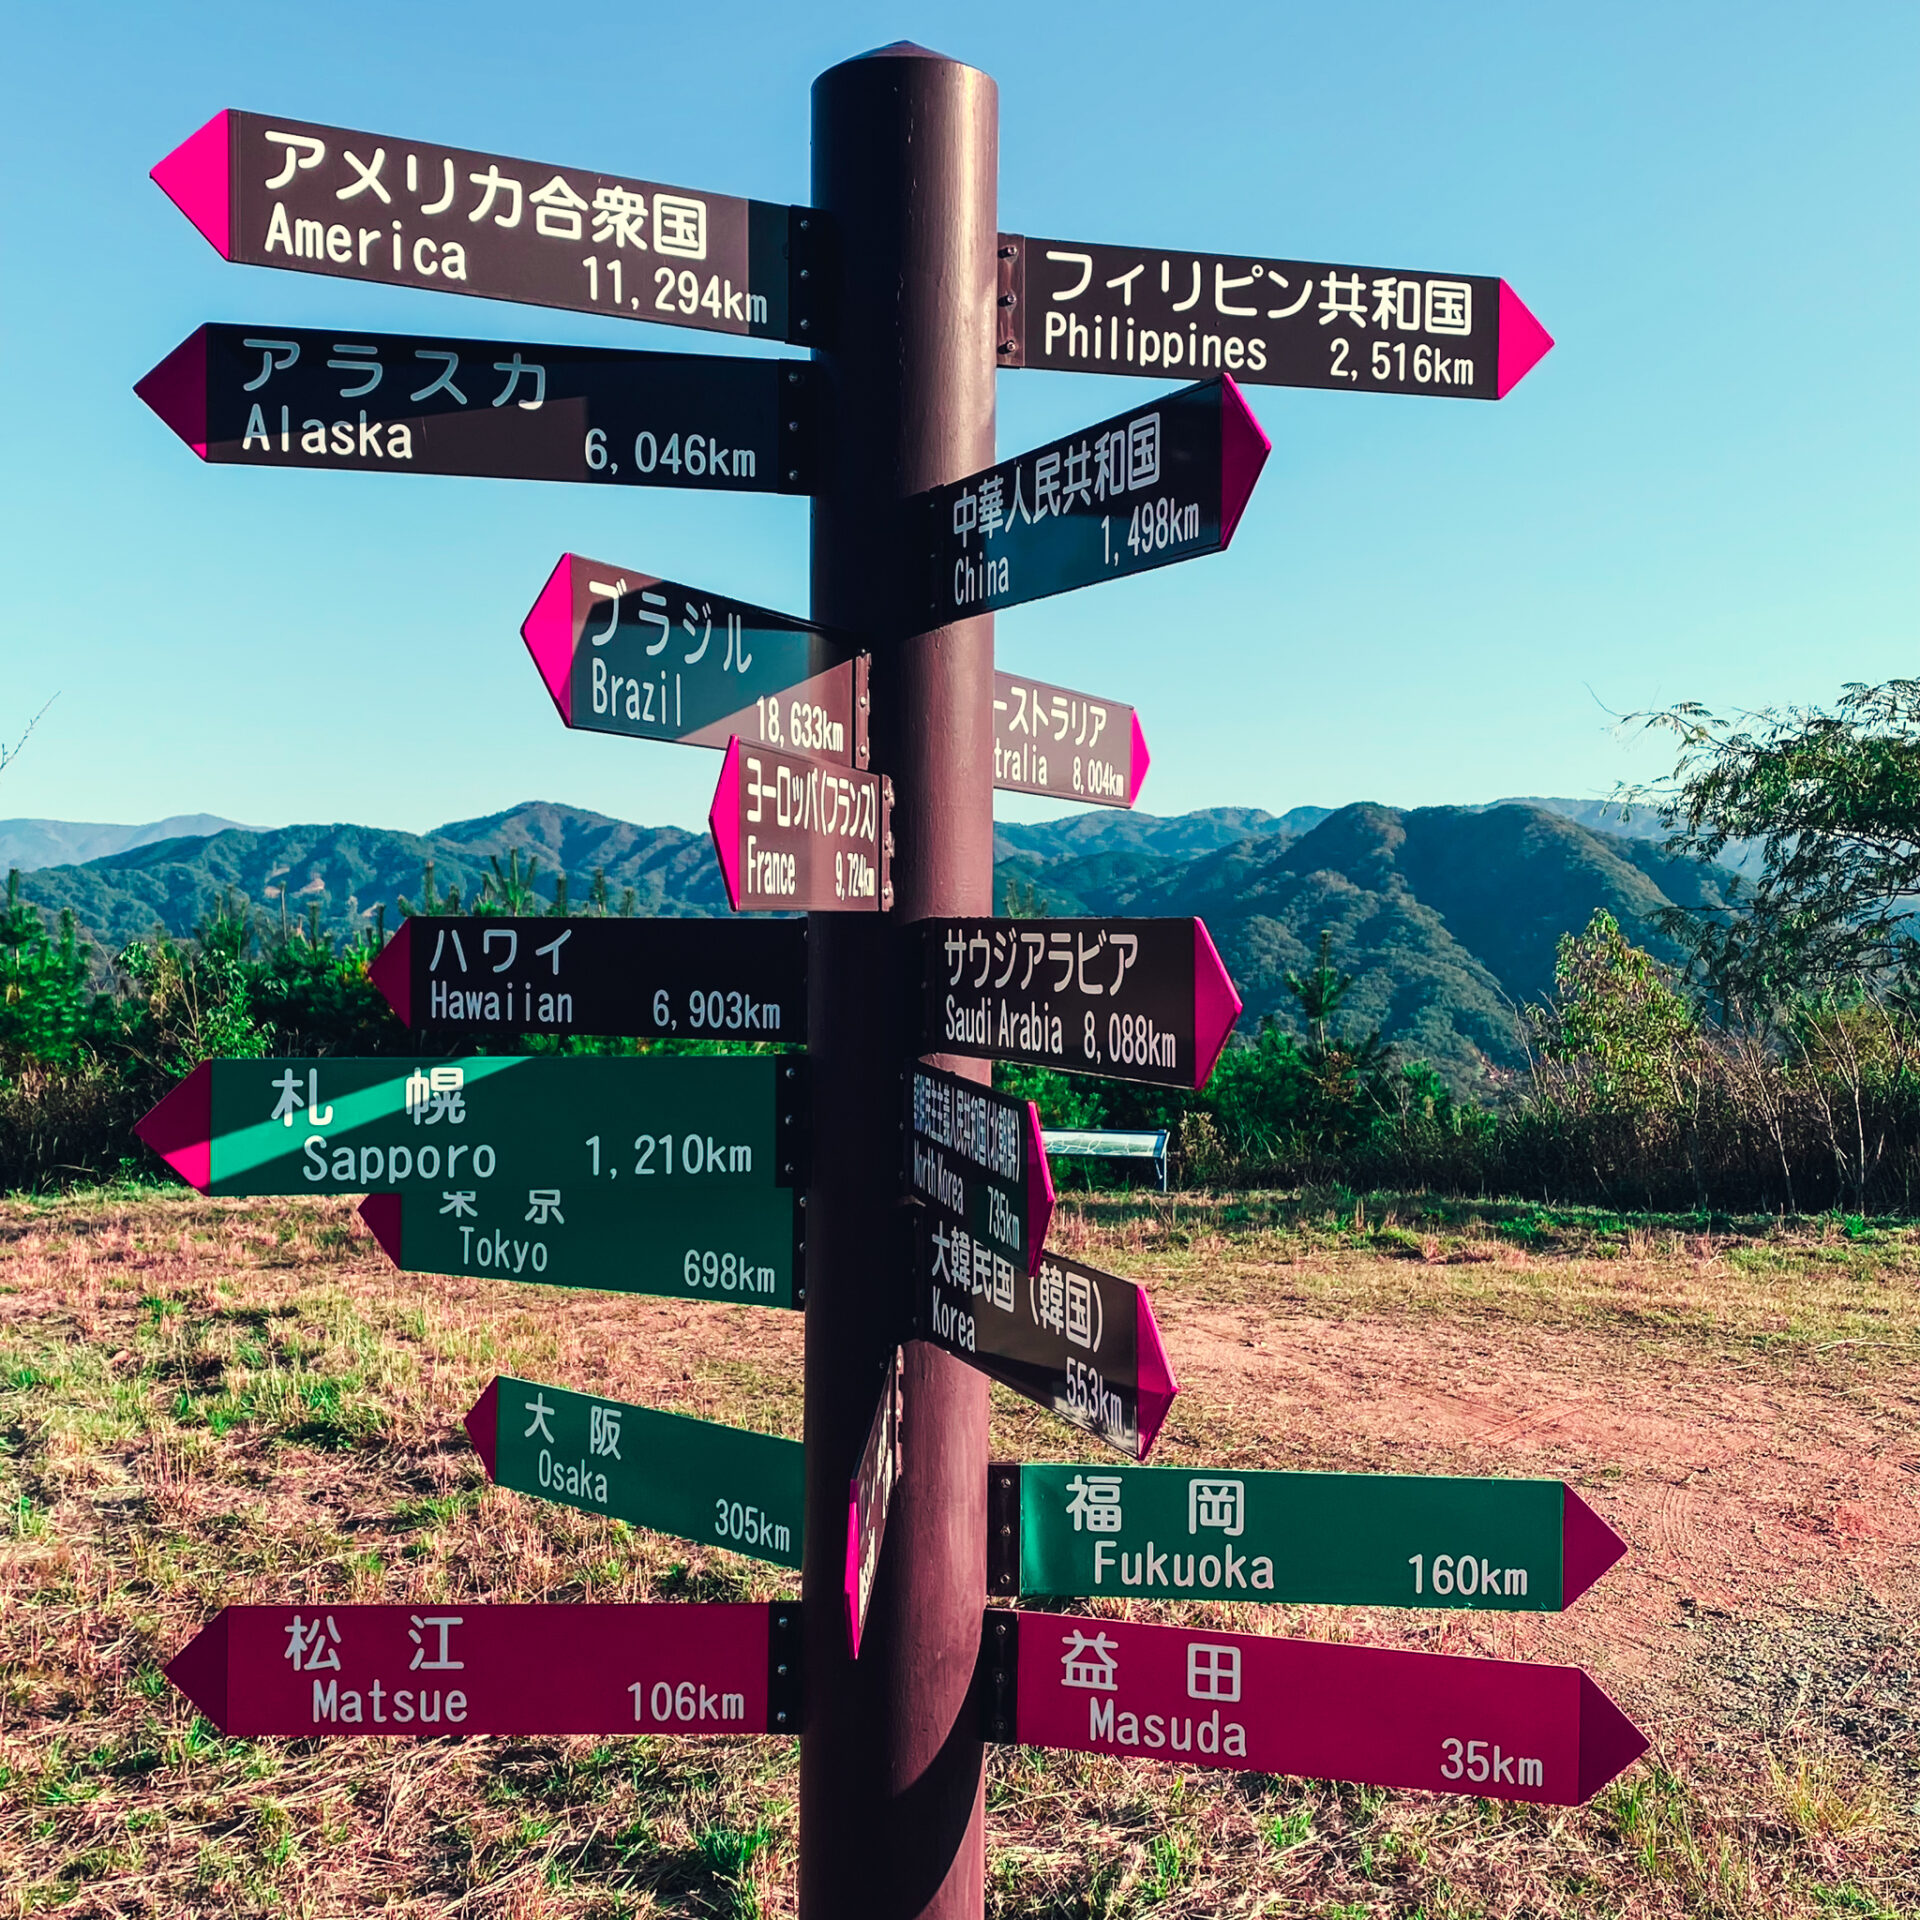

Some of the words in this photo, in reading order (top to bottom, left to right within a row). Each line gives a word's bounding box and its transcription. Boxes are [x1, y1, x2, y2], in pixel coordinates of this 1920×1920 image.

[264, 130, 707, 261] アメリカ合衆国
[264, 202, 467, 281] America
[1045, 250, 1473, 337] フィリピン共和国
[242, 338, 547, 411] アラスカ
[1044, 311, 1267, 371] Philippines
[241, 403, 413, 460] Alaska
[953, 412, 1161, 549] 中華人民共和国
[954, 556, 1010, 606] China
[589, 578, 752, 674] ブラジル
[592, 657, 681, 727] Brazil
[747, 835, 797, 895] France
[428, 928, 573, 976] ハワイ
[944, 926, 1139, 997] サウジアラビア
[430, 980, 573, 1025] Hawaiian
[945, 994, 992, 1046] Saudi
[998, 997, 1064, 1055] Arabia
[271, 1066, 467, 1128] 札幌
[303, 1136, 496, 1185] Sapporo
[914, 1139, 937, 1198] North
[937, 1153, 964, 1216] Korea
[987, 1185, 1020, 1251] 735km
[459, 1226, 548, 1273] Tokyo
[683, 1249, 776, 1294] 698km
[932, 1285, 976, 1354] Korea
[1066, 1356, 1125, 1436] 553km
[524, 1392, 622, 1461] 大阪
[538, 1449, 609, 1505] Osaka
[714, 1499, 791, 1553] 305km
[1066, 1474, 1245, 1537] 福岡
[1093, 1540, 1274, 1590] Fukuoka
[1407, 1553, 1528, 1597] 160km
[283, 1614, 466, 1672] 松江
[1060, 1629, 1241, 1703] 益田
[313, 1679, 468, 1724] Matsue
[626, 1681, 745, 1723] 106km
[1089, 1696, 1248, 1759] Masuda
[1440, 1737, 1545, 1787] 35km
